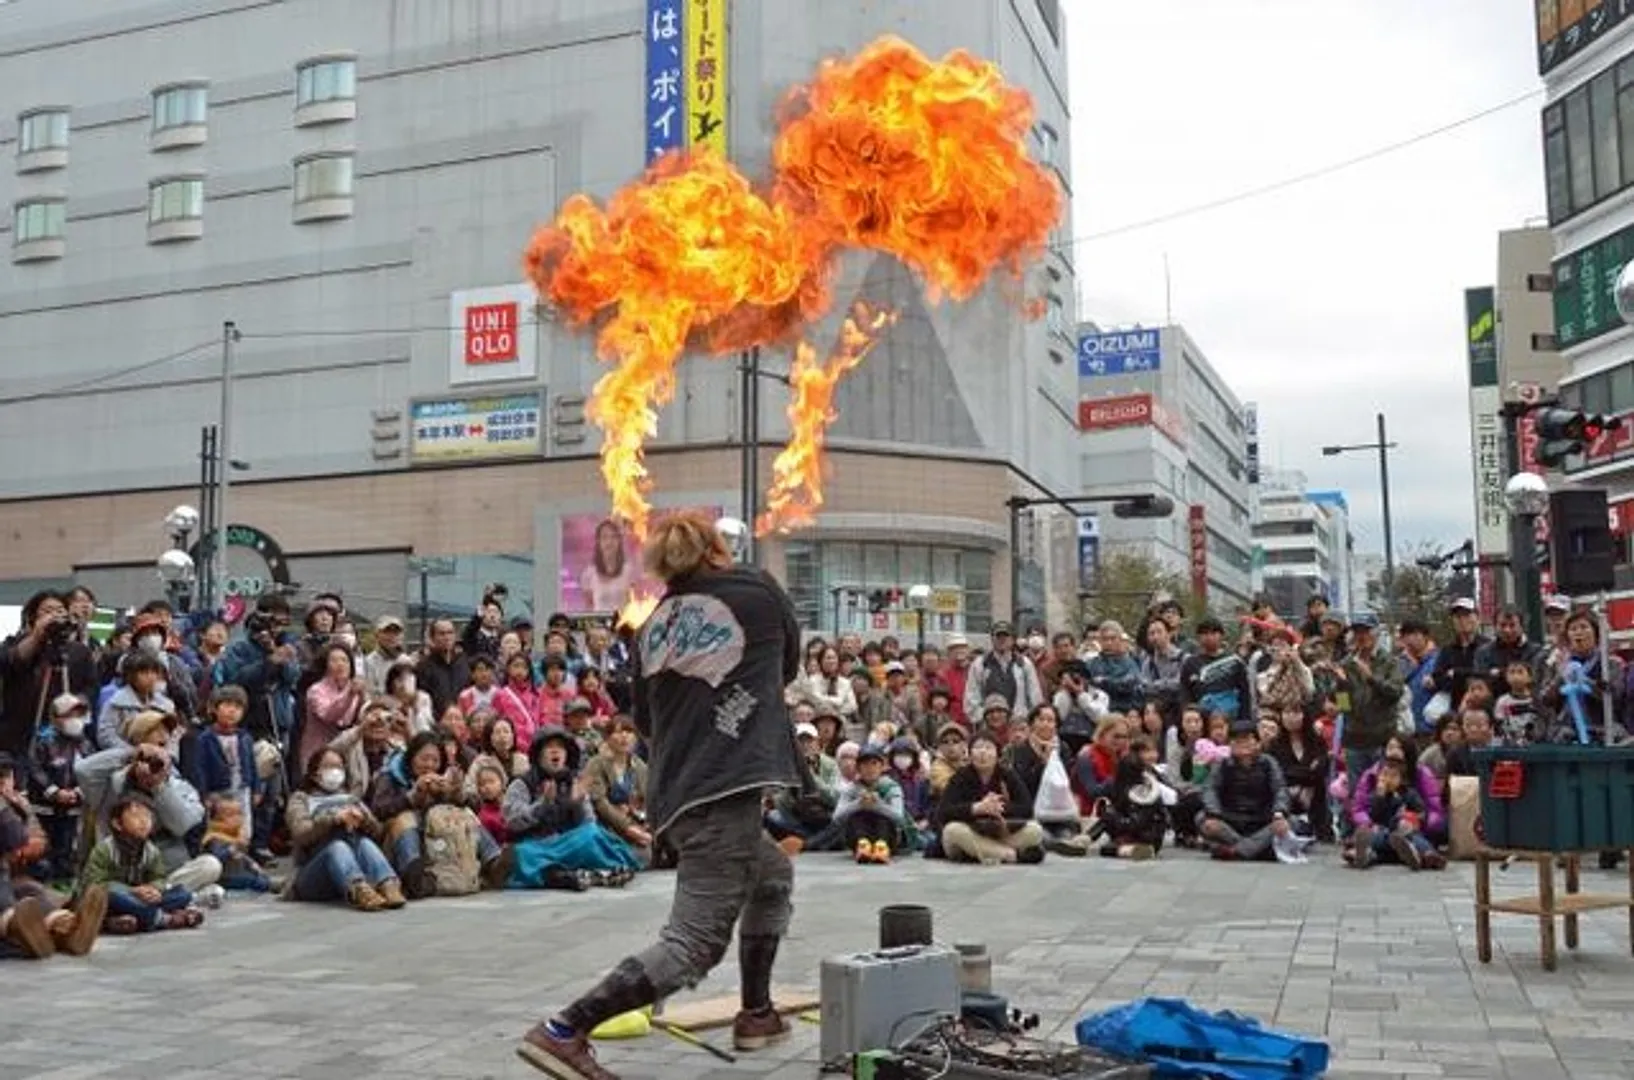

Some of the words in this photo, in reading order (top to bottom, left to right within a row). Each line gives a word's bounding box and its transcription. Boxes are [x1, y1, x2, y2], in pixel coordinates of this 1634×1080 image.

[651, 8, 680, 156] は、ポイ
[694, 0, 717, 106] ード祭り
[471, 310, 509, 332] UNI
[471, 334, 511, 356] QLO
[1083, 331, 1155, 355] OIZUMI
[1476, 412, 1501, 528] 三井住友銀行
